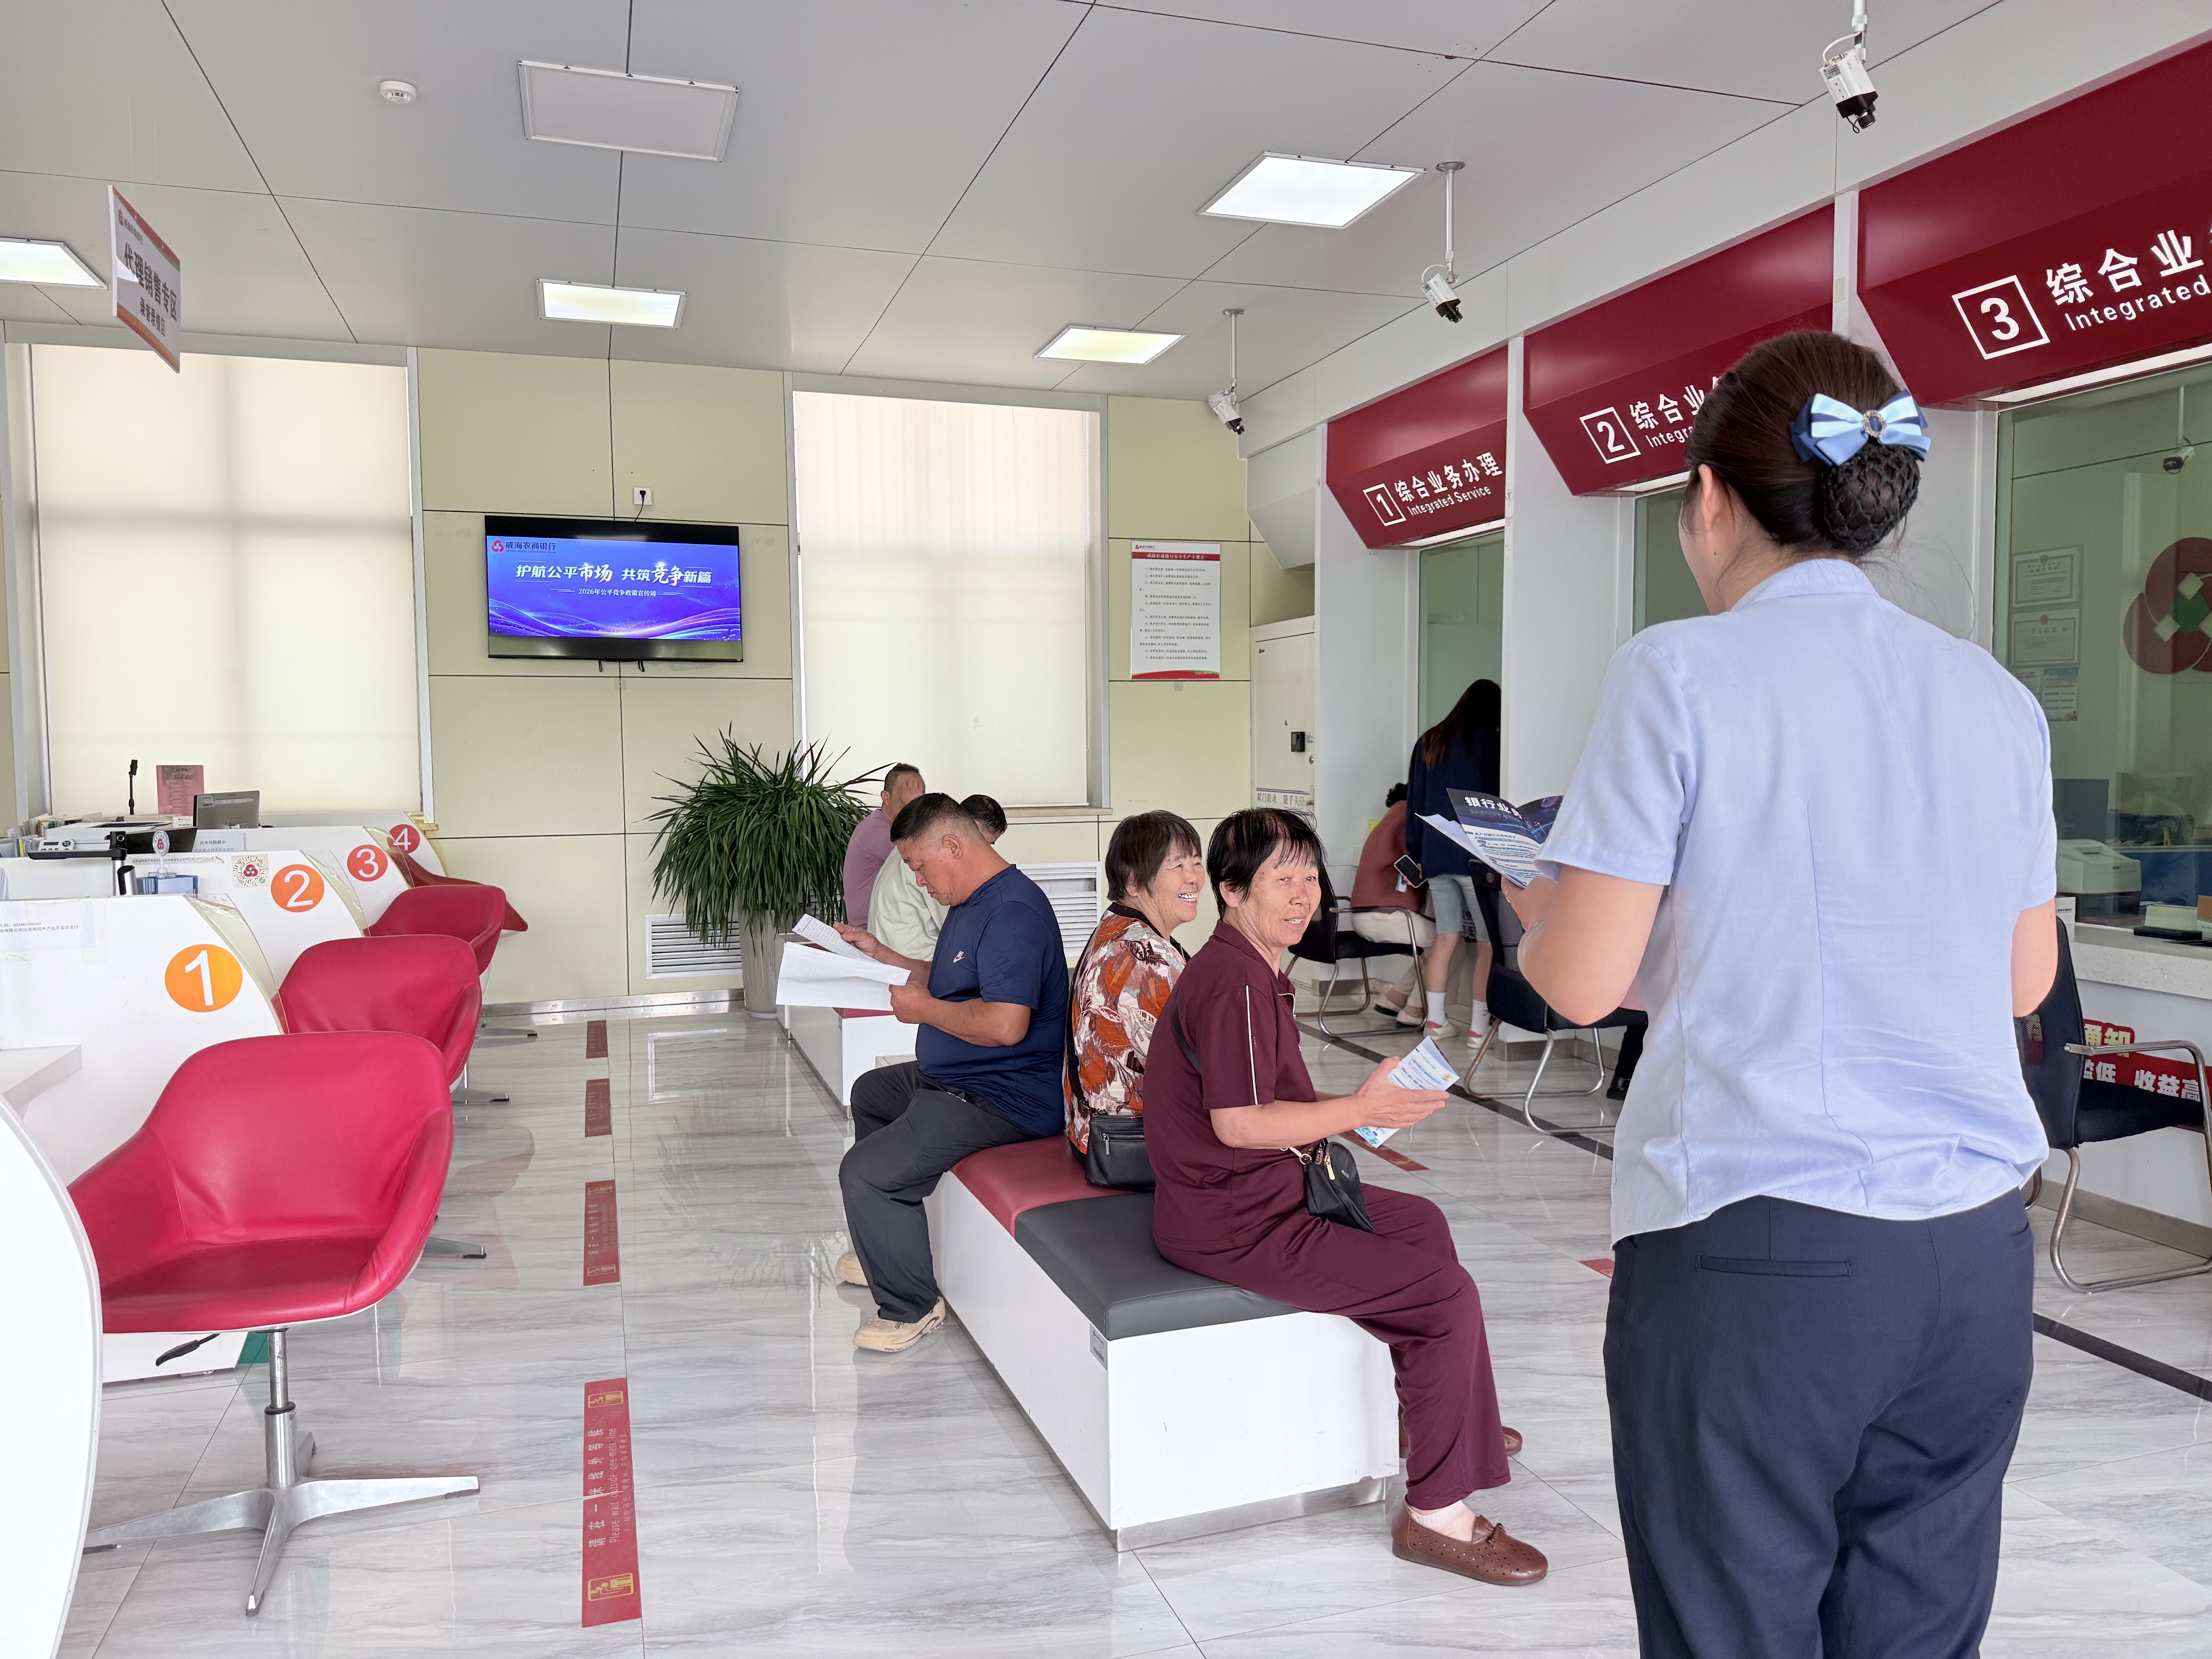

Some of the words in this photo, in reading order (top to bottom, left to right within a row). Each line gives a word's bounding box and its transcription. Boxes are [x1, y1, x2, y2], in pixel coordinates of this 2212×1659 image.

[124, 242, 177, 321] 代理销售专区
[2046, 229, 2212, 306] 综合业
[140, 297, 166, 337] 录音录像区
[1980, 297, 2020, 340] 3
[2064, 274, 2212, 331] Integrated
[1629, 376, 1723, 430] 综合业
[1597, 421, 1626, 453] 2
[1394, 452, 1503, 503] 综合业务办理
[1376, 493, 1394, 517] 1
[1407, 494, 1455, 516] Integrated
[1454, 485, 1491, 503] Service
[506, 541, 556, 550] 威海农商银行
[516, 562, 613, 584] 护航公平市场
[621, 563, 712, 587] 共筑竞争新篇
[578, 587, 657, 597] 2026年公平竞争政策宣传周
[393, 828, 411, 850] 4
[355, 848, 380, 878] 3
[283, 870, 314, 908] 2
[185, 950, 214, 1006] 1
[2134, 1069, 2201, 1103] 收益高
[607, 1428, 616, 1439] line
[587, 1428, 606, 1547] 请在一米线外等候
[608, 1502, 619, 1516] wait
[609, 1520, 620, 1543] Please
